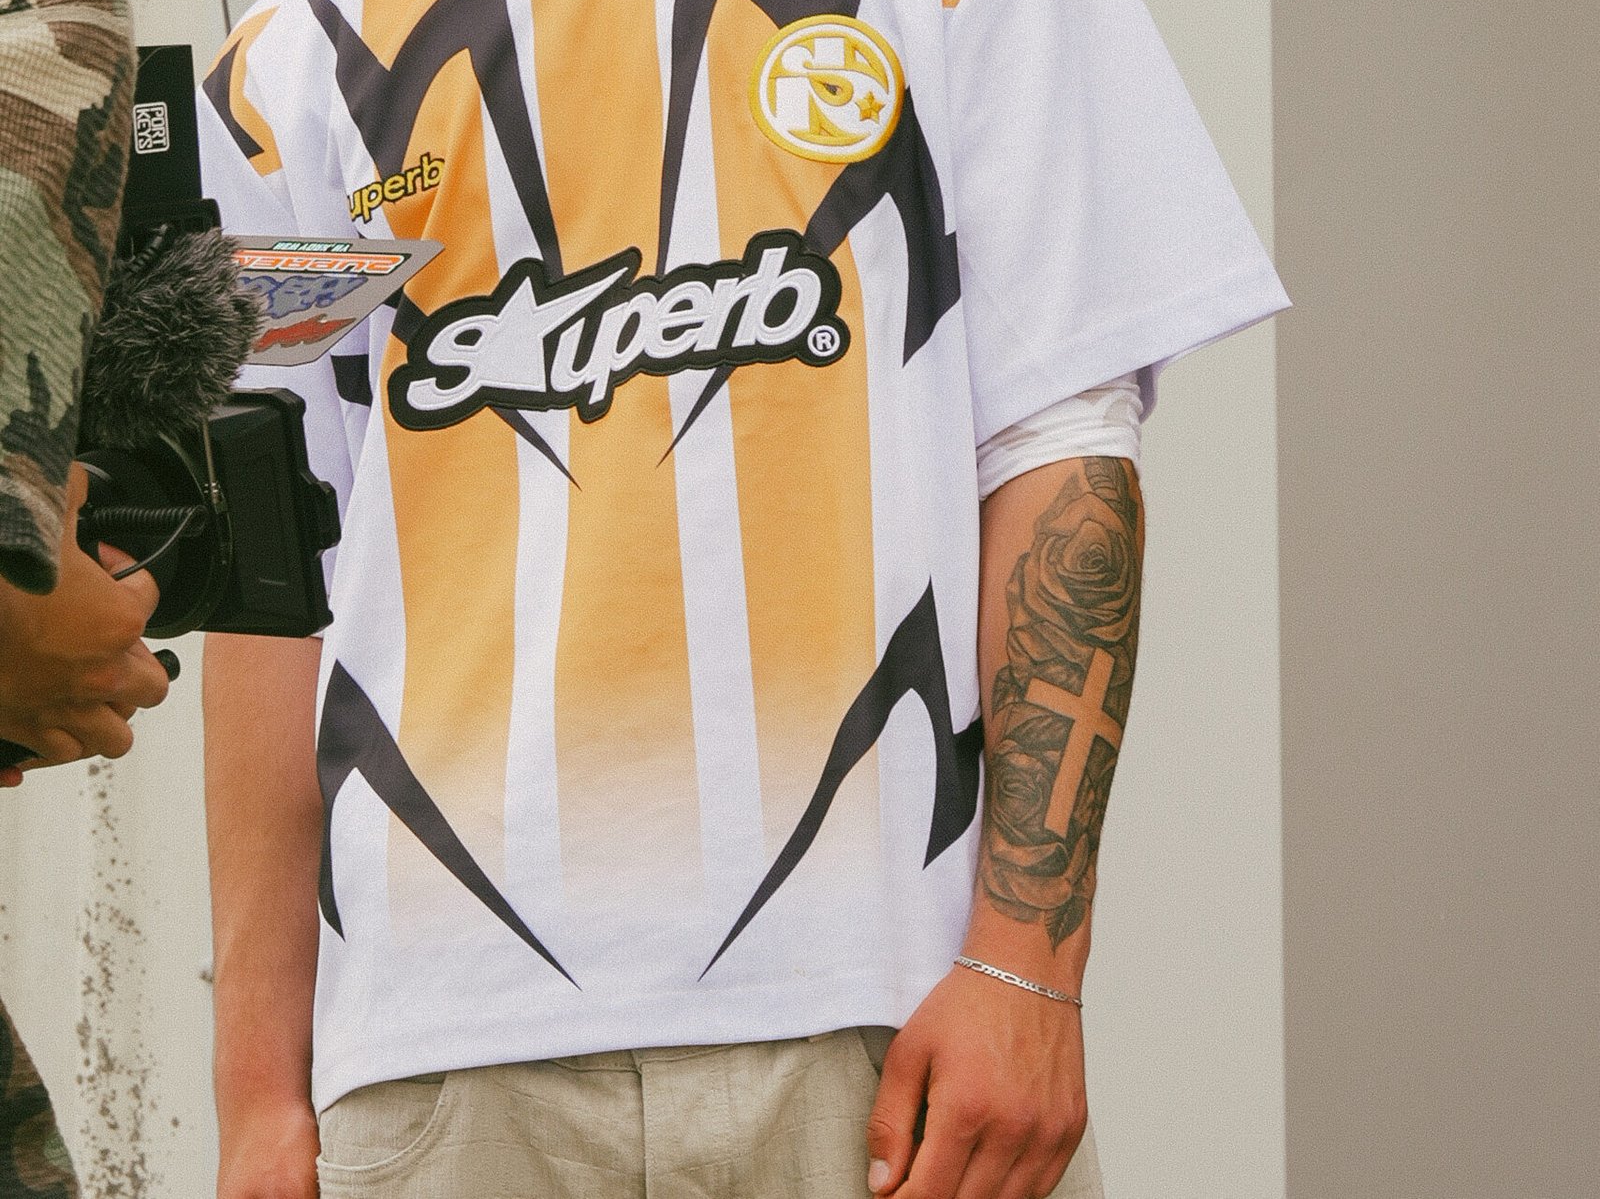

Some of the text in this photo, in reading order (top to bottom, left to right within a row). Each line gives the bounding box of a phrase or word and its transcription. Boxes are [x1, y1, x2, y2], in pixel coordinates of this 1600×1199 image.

[136, 108, 153, 149] KEYS
[150, 106, 167, 146] PORT
[347, 151, 446, 224] uperb
